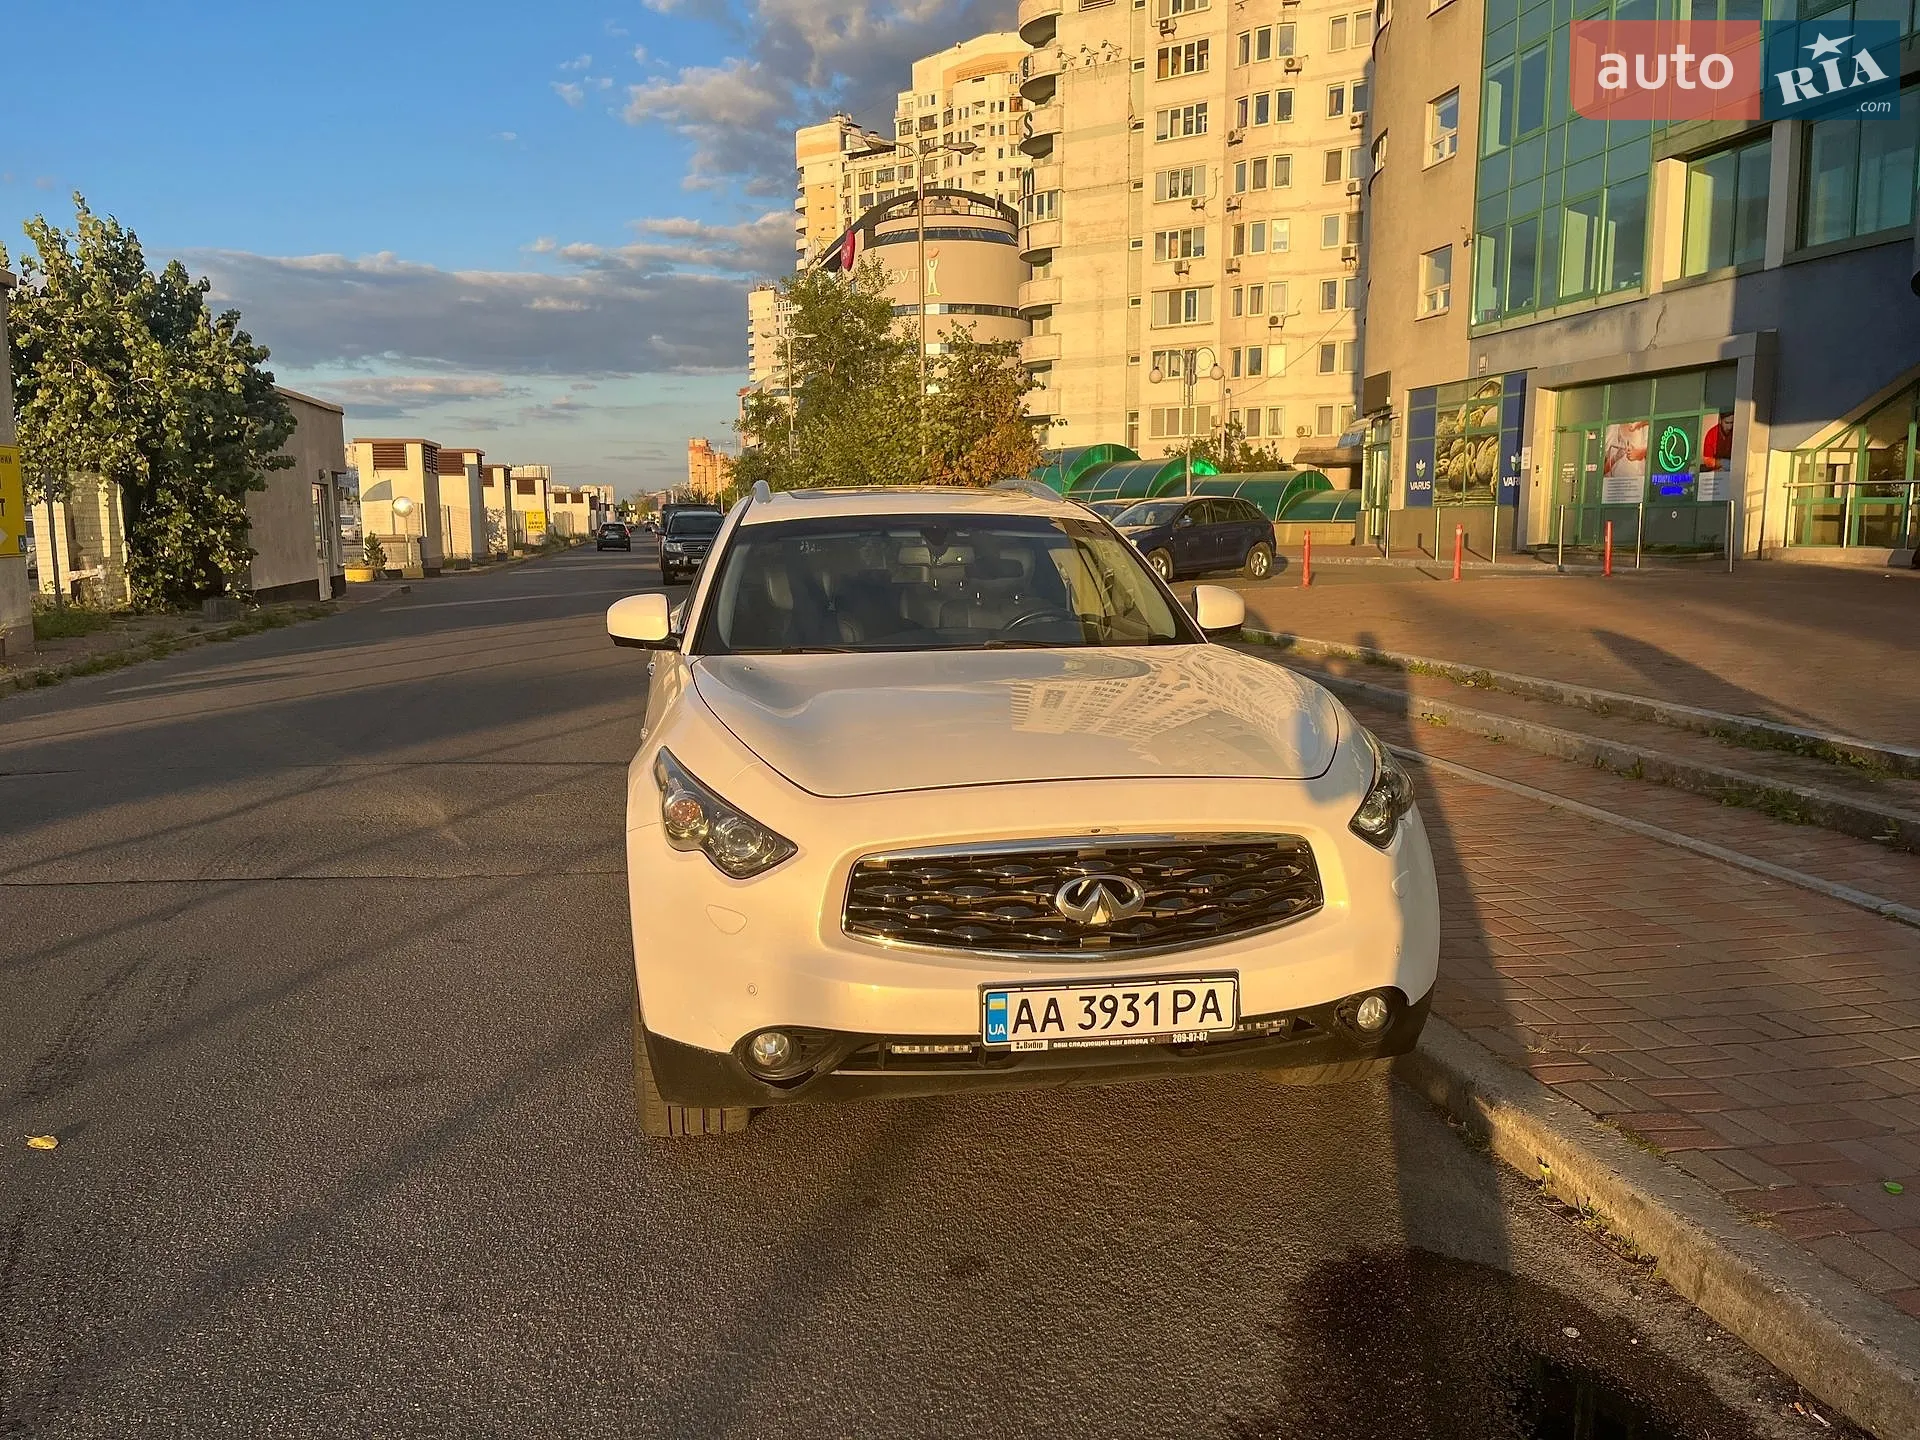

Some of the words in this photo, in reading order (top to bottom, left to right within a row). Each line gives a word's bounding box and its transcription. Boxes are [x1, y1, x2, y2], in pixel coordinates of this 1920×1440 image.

[1409, 480, 1431, 491] VARUS
[1012, 997, 1065, 1034] AA
[1078, 991, 1159, 1031] 3931
[1172, 989, 1223, 1025] PA
[988, 1023, 1006, 1035] UA
